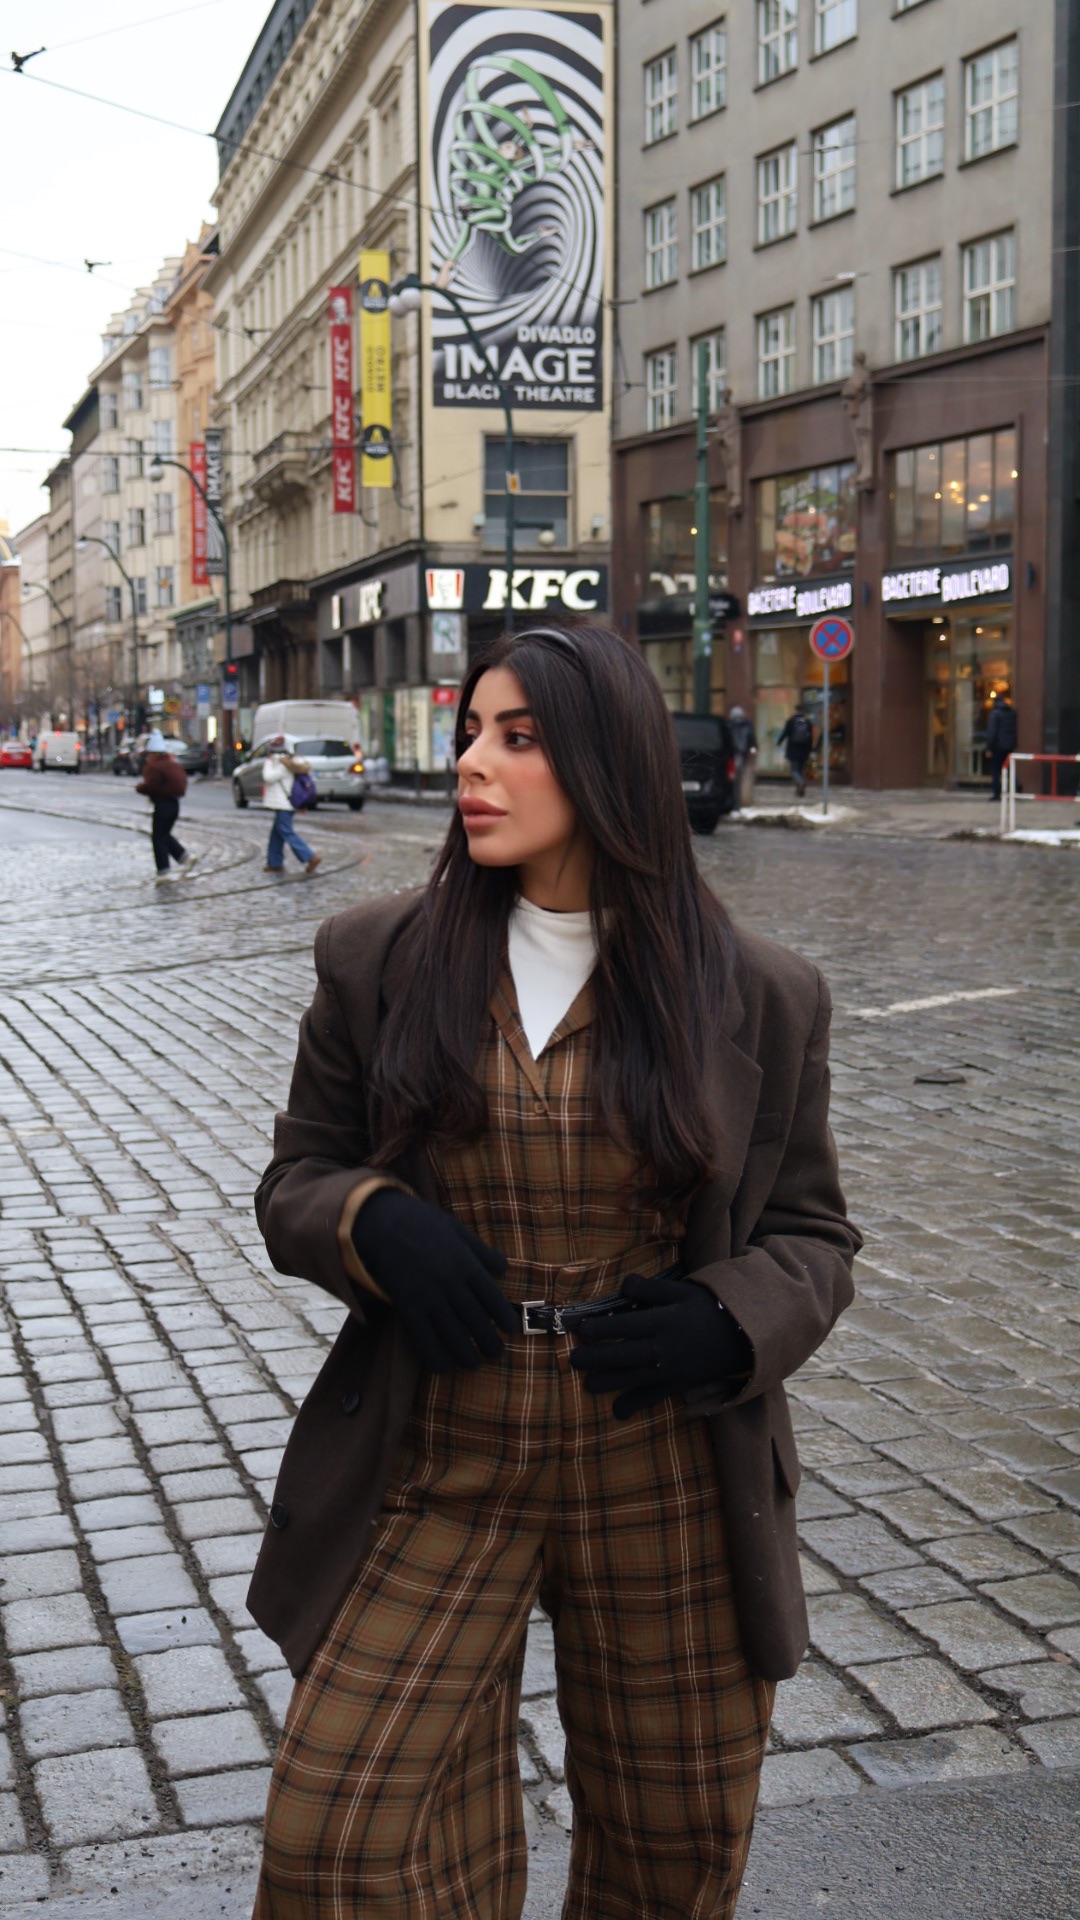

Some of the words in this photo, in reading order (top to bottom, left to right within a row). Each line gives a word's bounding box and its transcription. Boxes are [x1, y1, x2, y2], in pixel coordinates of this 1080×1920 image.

[517, 324, 596, 344] DIVADLO
[334, 336, 349, 382] KFC
[443, 343, 596, 383] IMAGE
[514, 385, 596, 403] THEATRE
[335, 395, 350, 440] KFC
[206, 439, 221, 500] IMAGE
[337, 457, 352, 502] KFC
[359, 580, 382, 624] KFC
[482, 569, 600, 610] KFC
